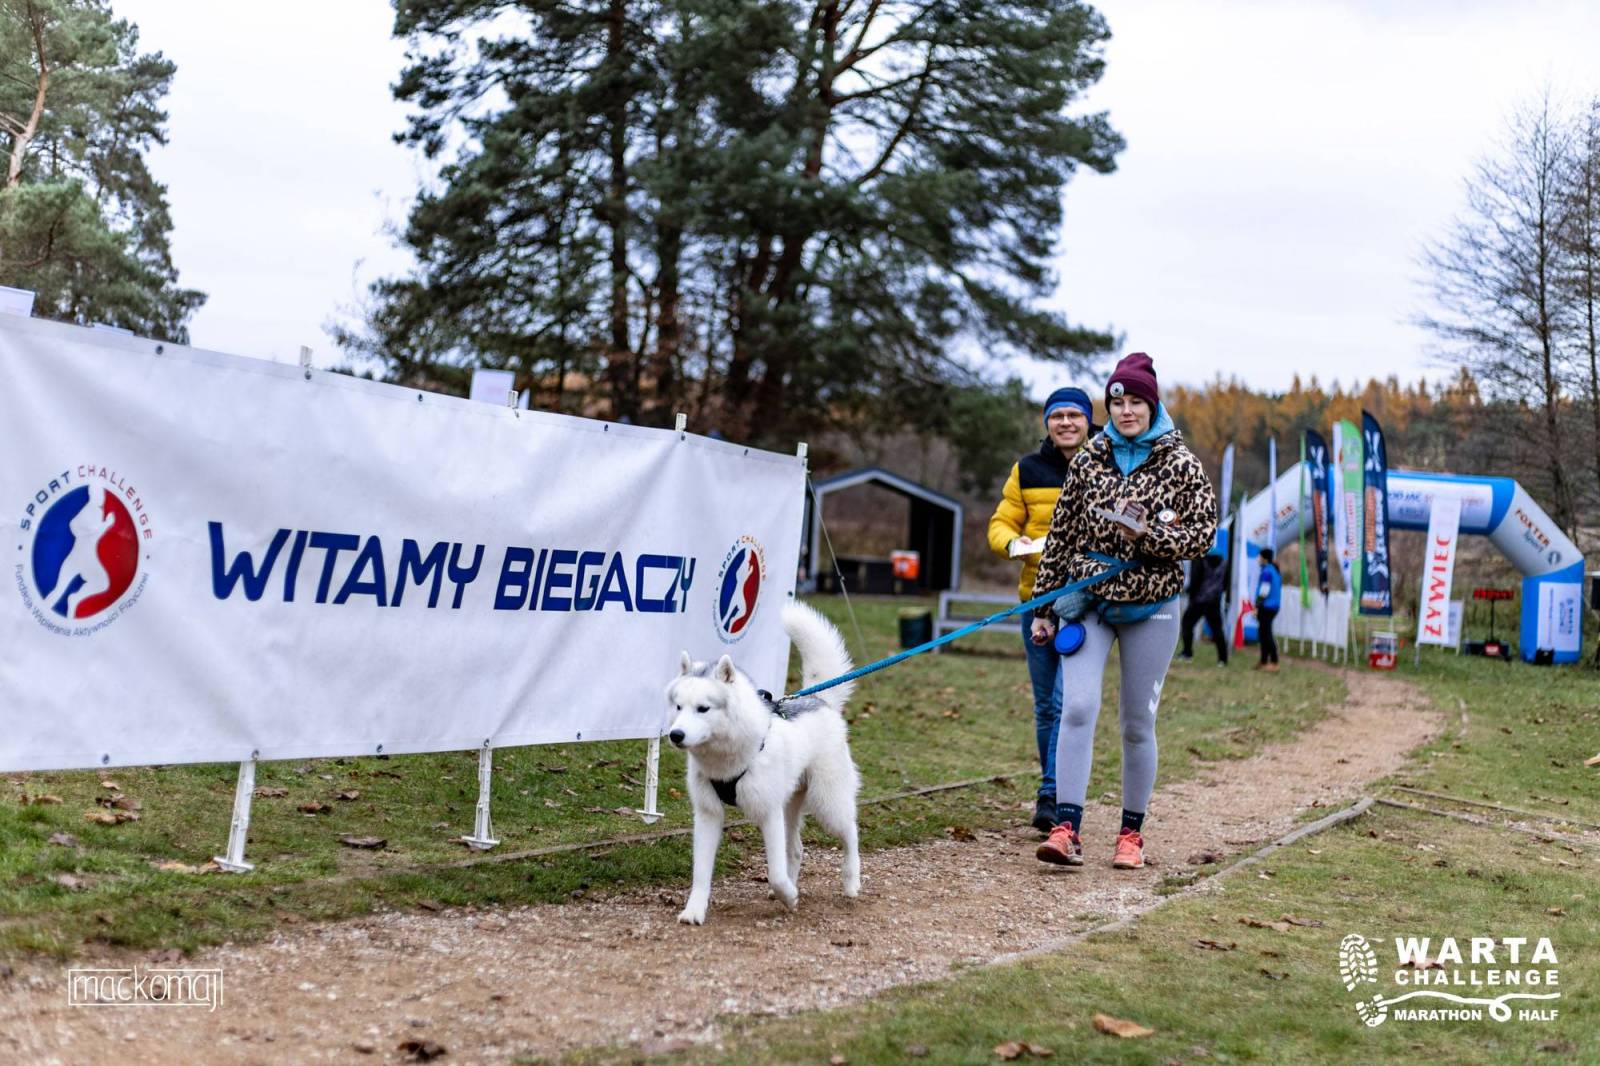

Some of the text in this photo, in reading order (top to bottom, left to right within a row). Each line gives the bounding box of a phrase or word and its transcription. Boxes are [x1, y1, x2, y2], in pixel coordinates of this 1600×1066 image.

[20, 464, 153, 540] SPORT CHALLENGE
[208, 521, 696, 613] WITAMY BIEGACZY
